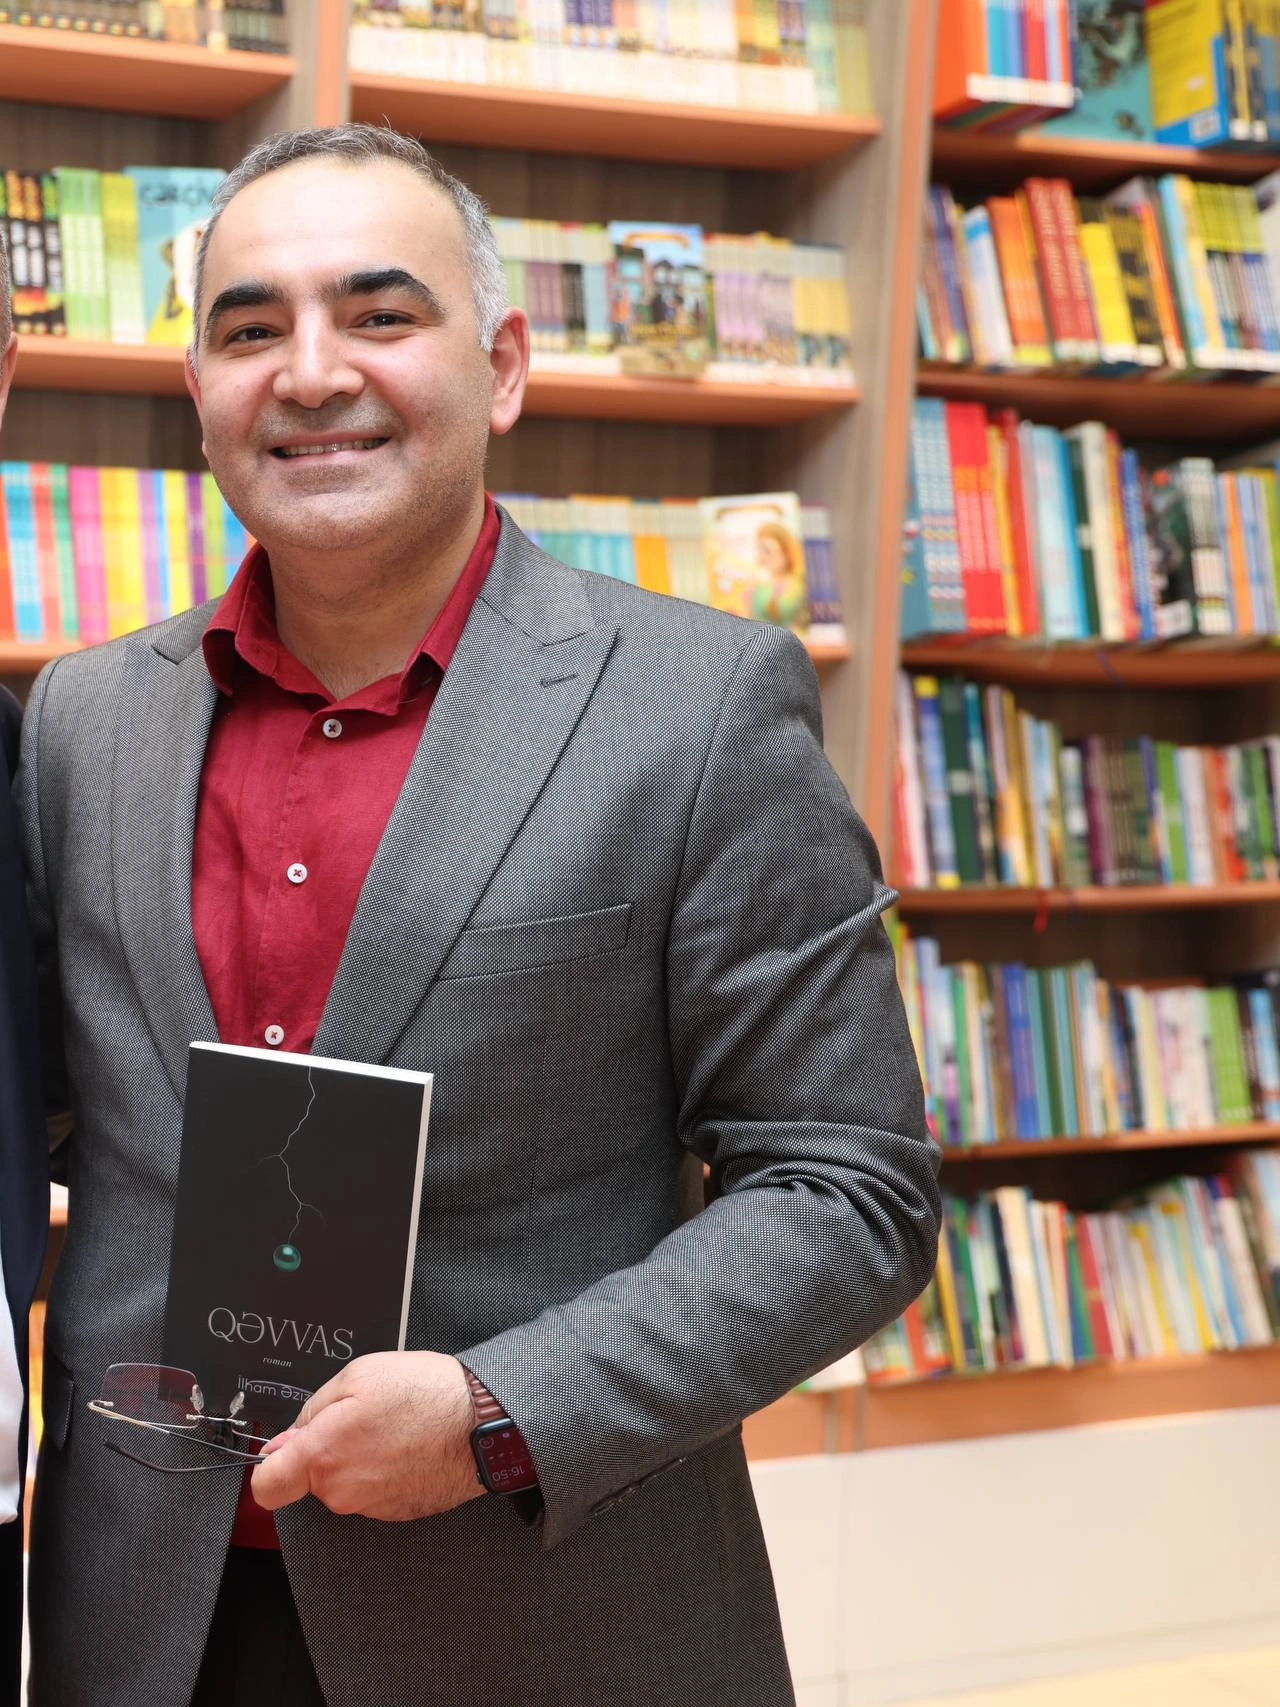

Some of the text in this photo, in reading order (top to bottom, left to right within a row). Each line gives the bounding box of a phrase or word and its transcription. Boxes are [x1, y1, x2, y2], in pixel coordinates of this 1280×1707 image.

[207, 1307, 353, 1360] QƏVVAS
[262, 1356, 292, 1367] roman
[491, 1465, 525, 1481] 16:50
